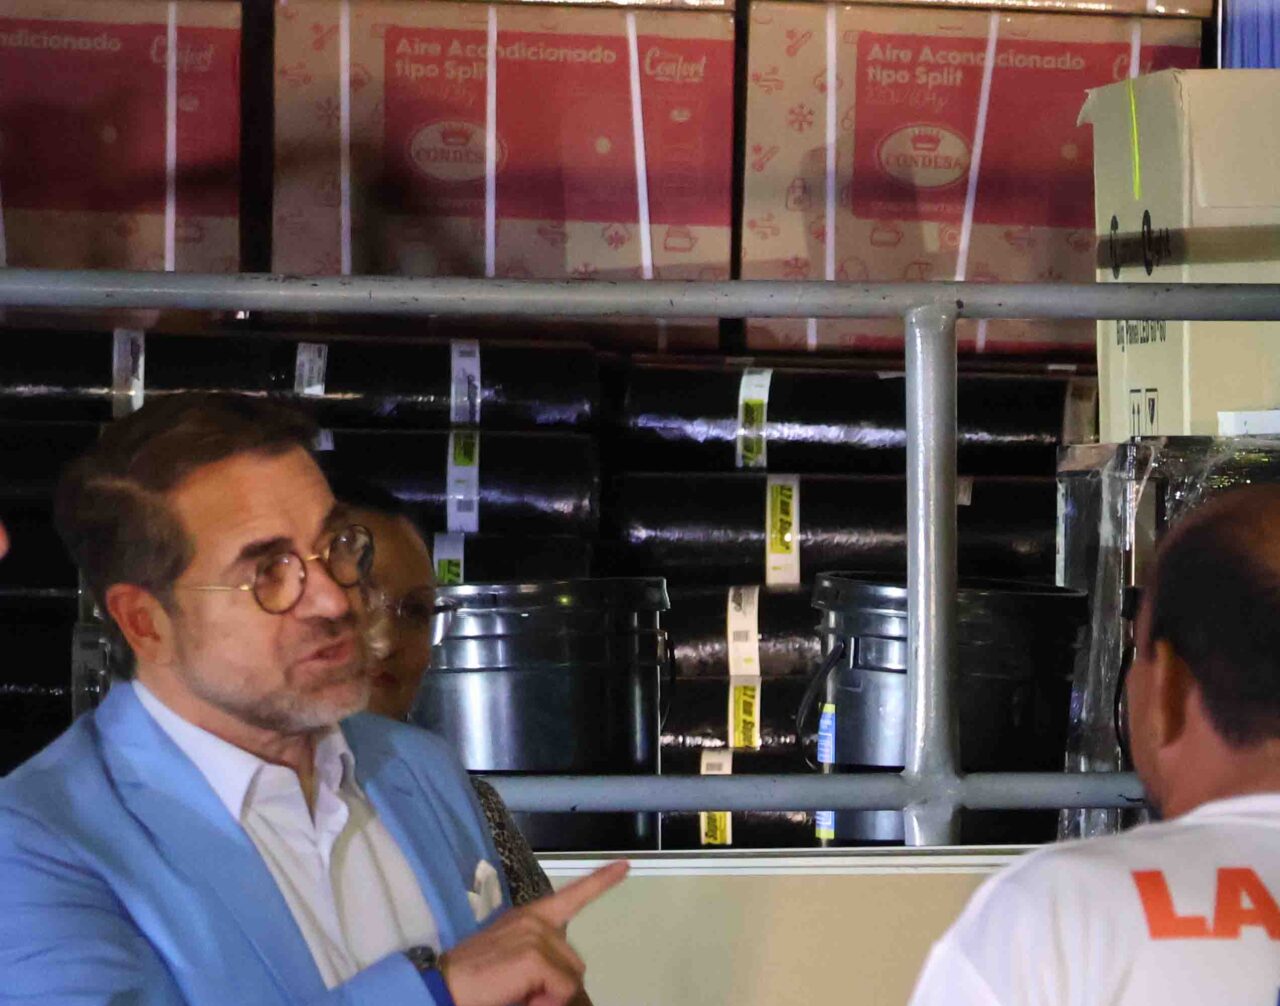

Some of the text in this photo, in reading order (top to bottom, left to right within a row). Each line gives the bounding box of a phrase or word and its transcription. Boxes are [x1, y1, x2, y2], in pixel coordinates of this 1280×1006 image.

[396, 38, 441, 57] Aire
[868, 43, 912, 64] Aire
[395, 60, 440, 81] tipo
[867, 65, 964, 89] tipo Split
